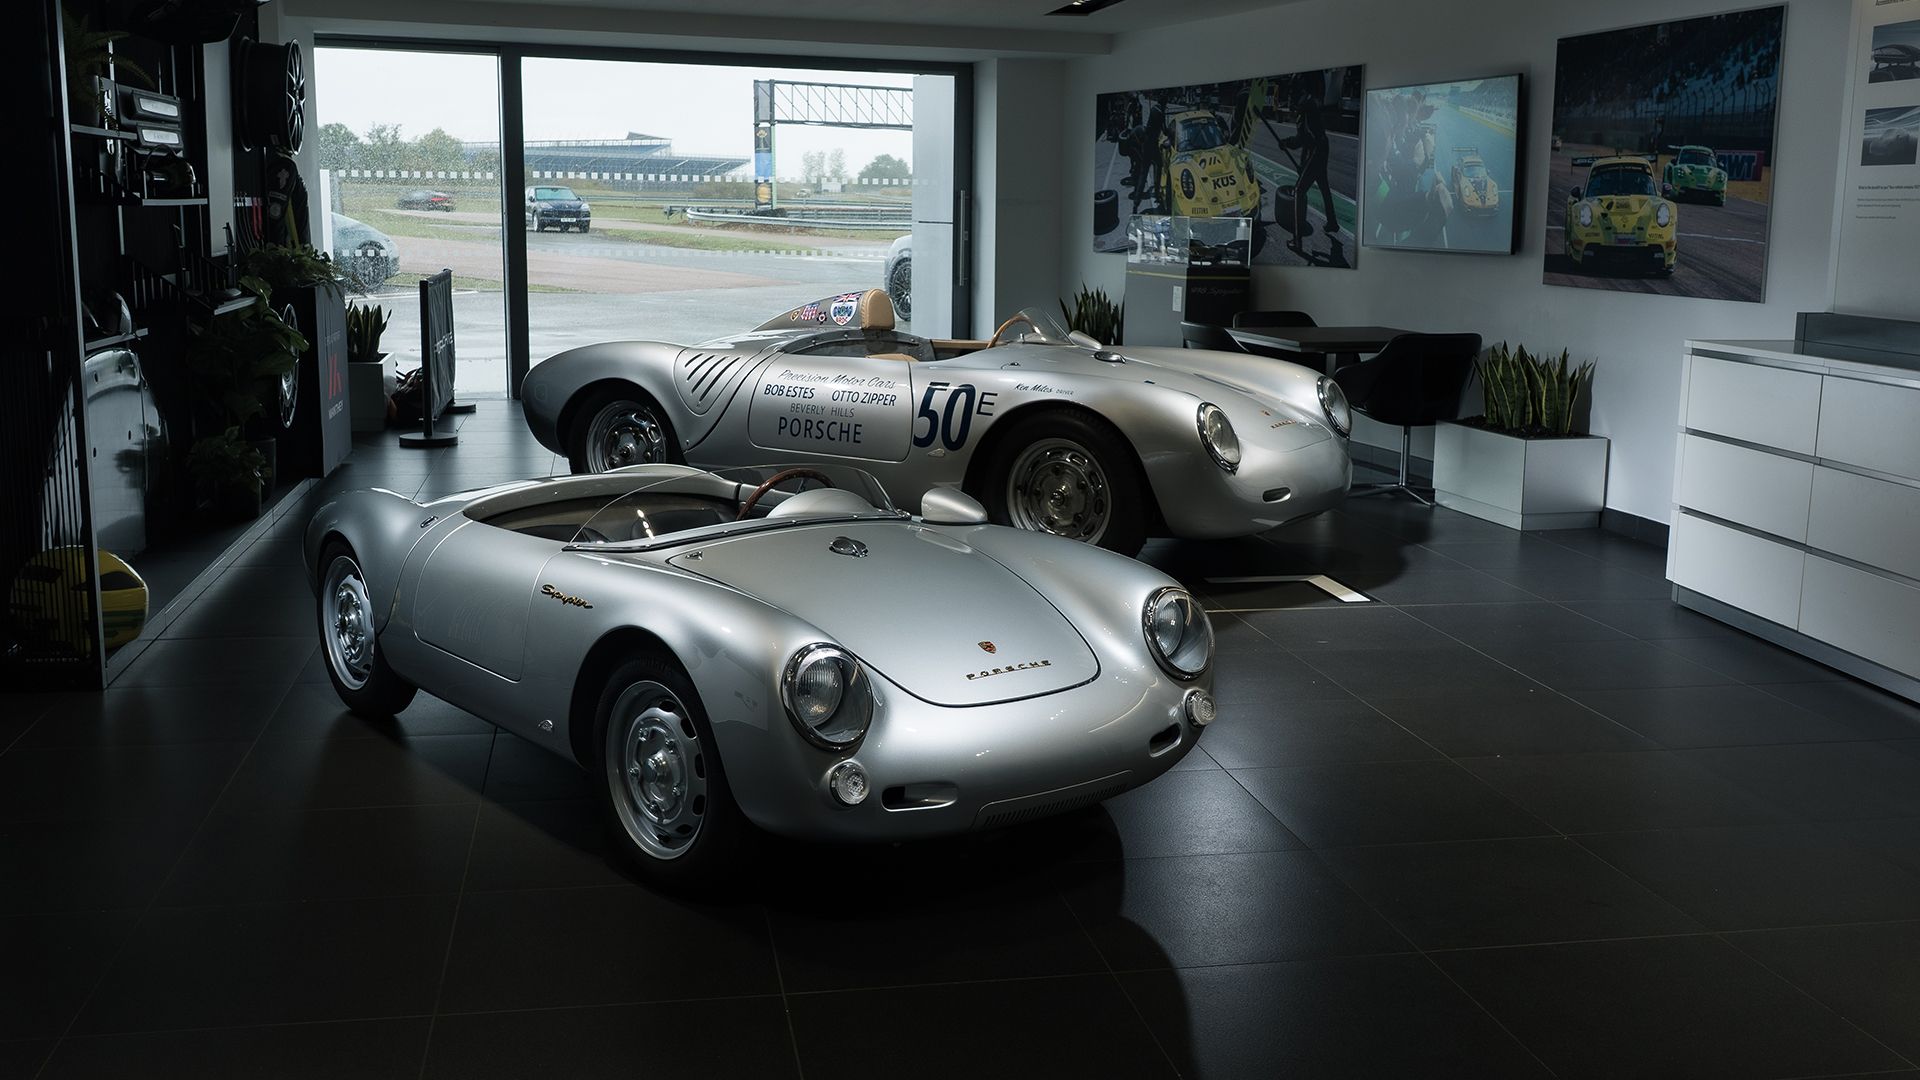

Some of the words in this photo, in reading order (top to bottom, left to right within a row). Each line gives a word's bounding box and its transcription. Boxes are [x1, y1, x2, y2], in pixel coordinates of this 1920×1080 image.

[1212, 175, 1237, 190] KÜS
[778, 369, 830, 384] Precision
[830, 374, 866, 387] Motor
[867, 376, 897, 390] Cars
[1014, 383, 1030, 391] Ken
[1031, 384, 1054, 393] Miles
[764, 383, 785, 397] BOB
[785, 385, 816, 399] ESTES
[831, 390, 860, 403] OTTO
[860, 392, 897, 406] ZIPPER
[790, 403, 826, 415] BEVERLY
[830, 407, 855, 418] HILLS
[913, 382, 976, 451] 50
[976, 391, 998, 416] E
[778, 416, 863, 444] PORSCHE
[540, 584, 594, 610] Spyder
[966, 659, 1052, 680] PORSCHE
